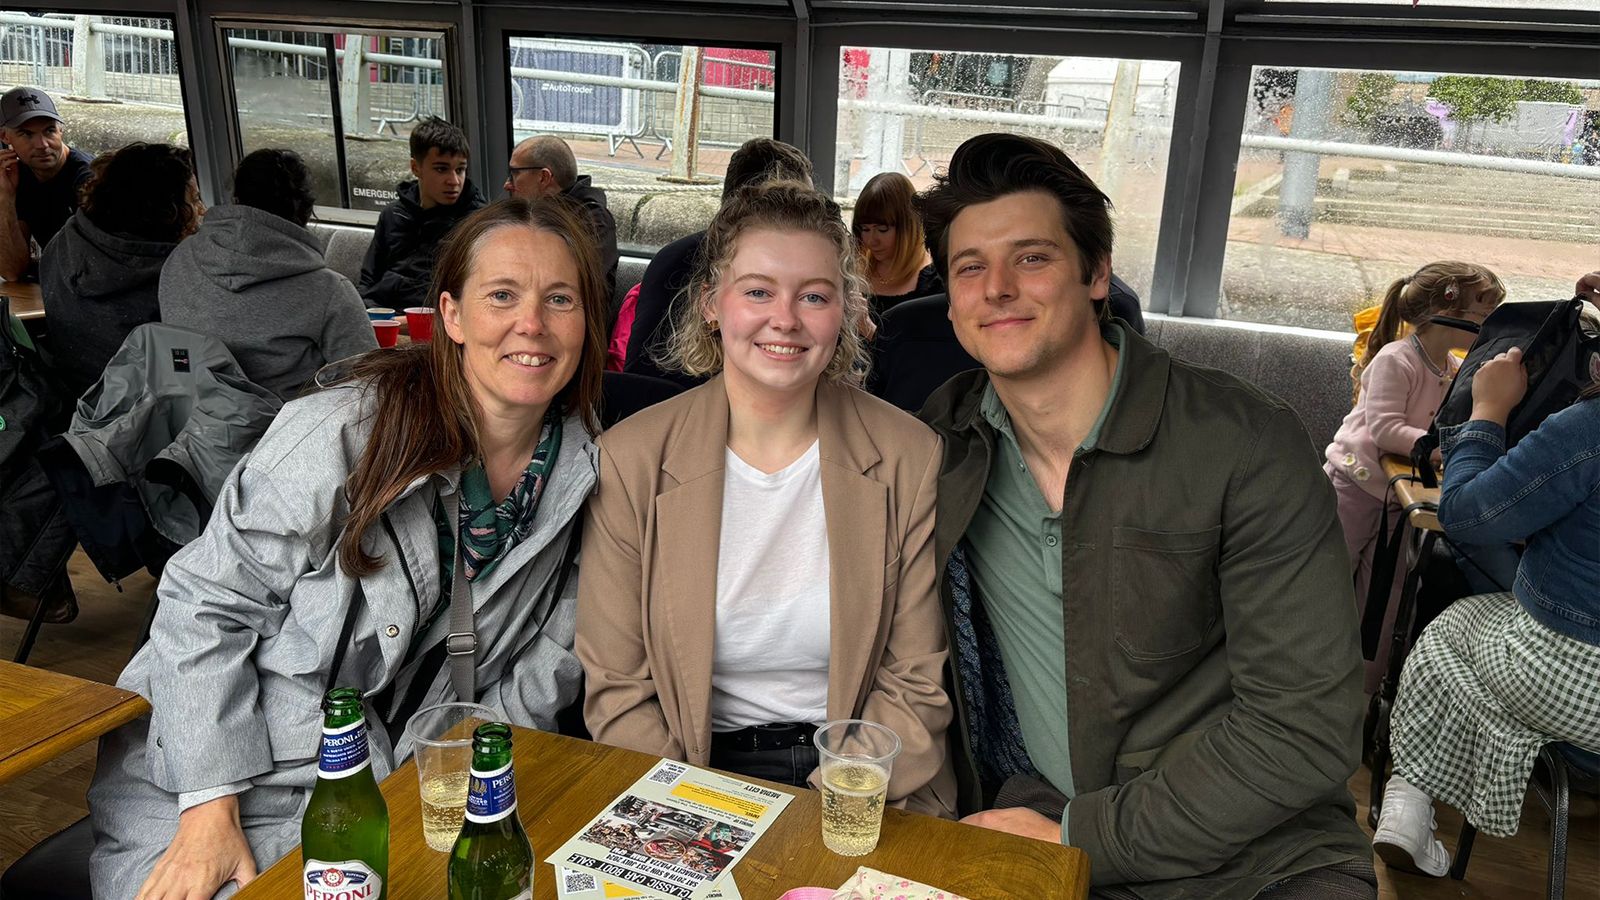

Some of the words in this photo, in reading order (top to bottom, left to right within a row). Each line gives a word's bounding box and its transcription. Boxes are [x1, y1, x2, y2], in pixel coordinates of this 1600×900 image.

[353, 187, 400, 200] EMERGENC
[323, 734, 354, 747] PERONI
[744, 785, 761, 793] CITY
[760, 789, 781, 799] MEDIA
[569, 854, 597, 867] SALE
[621, 859, 638, 867] JULY
[650, 859, 673, 870] PIAZZA
[595, 862, 626, 877] BOOT
[636, 863, 651, 871] 21ST
[650, 867, 665, 876] SUN
[624, 871, 647, 884] CAR
[668, 874, 687, 883] 20TH
[673, 866, 706, 881] MEDIACITY
[646, 878, 691, 898] CLASSIC
[685, 879, 699, 887] SAT
